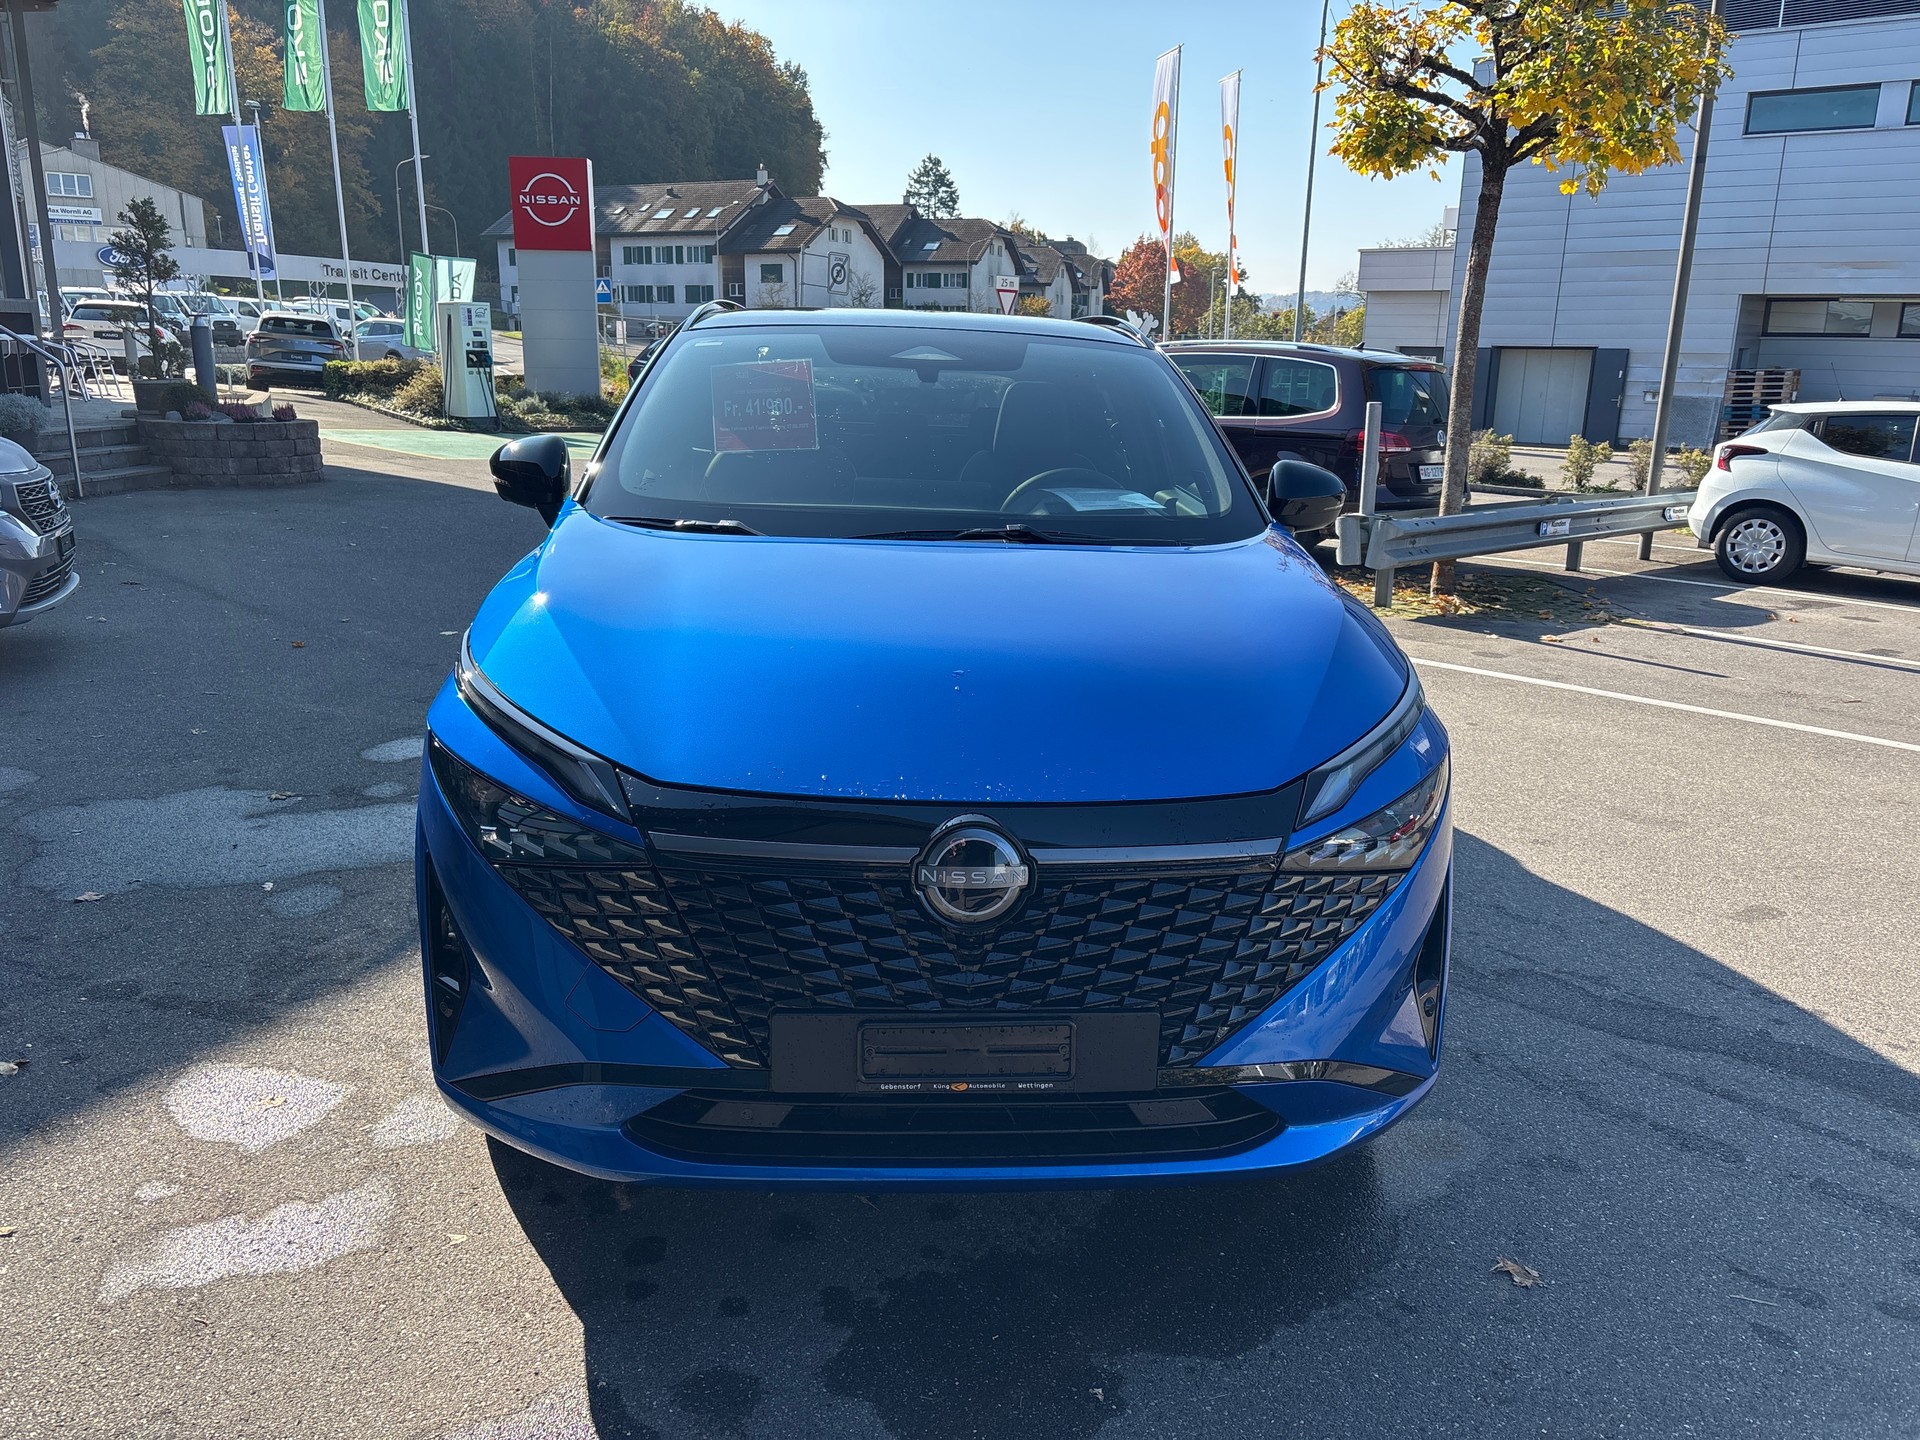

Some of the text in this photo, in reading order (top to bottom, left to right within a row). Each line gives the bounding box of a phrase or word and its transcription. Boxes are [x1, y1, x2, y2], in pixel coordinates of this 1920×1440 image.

[519, 194, 581, 205] NISSAN
[1001, 278, 1008, 287] 25
[724, 400, 742, 417] Fr.
[921, 868, 1027, 884] NISSAN
[933, 1083, 950, 1091] Küng
[1017, 1081, 1054, 1090] Wettingen
